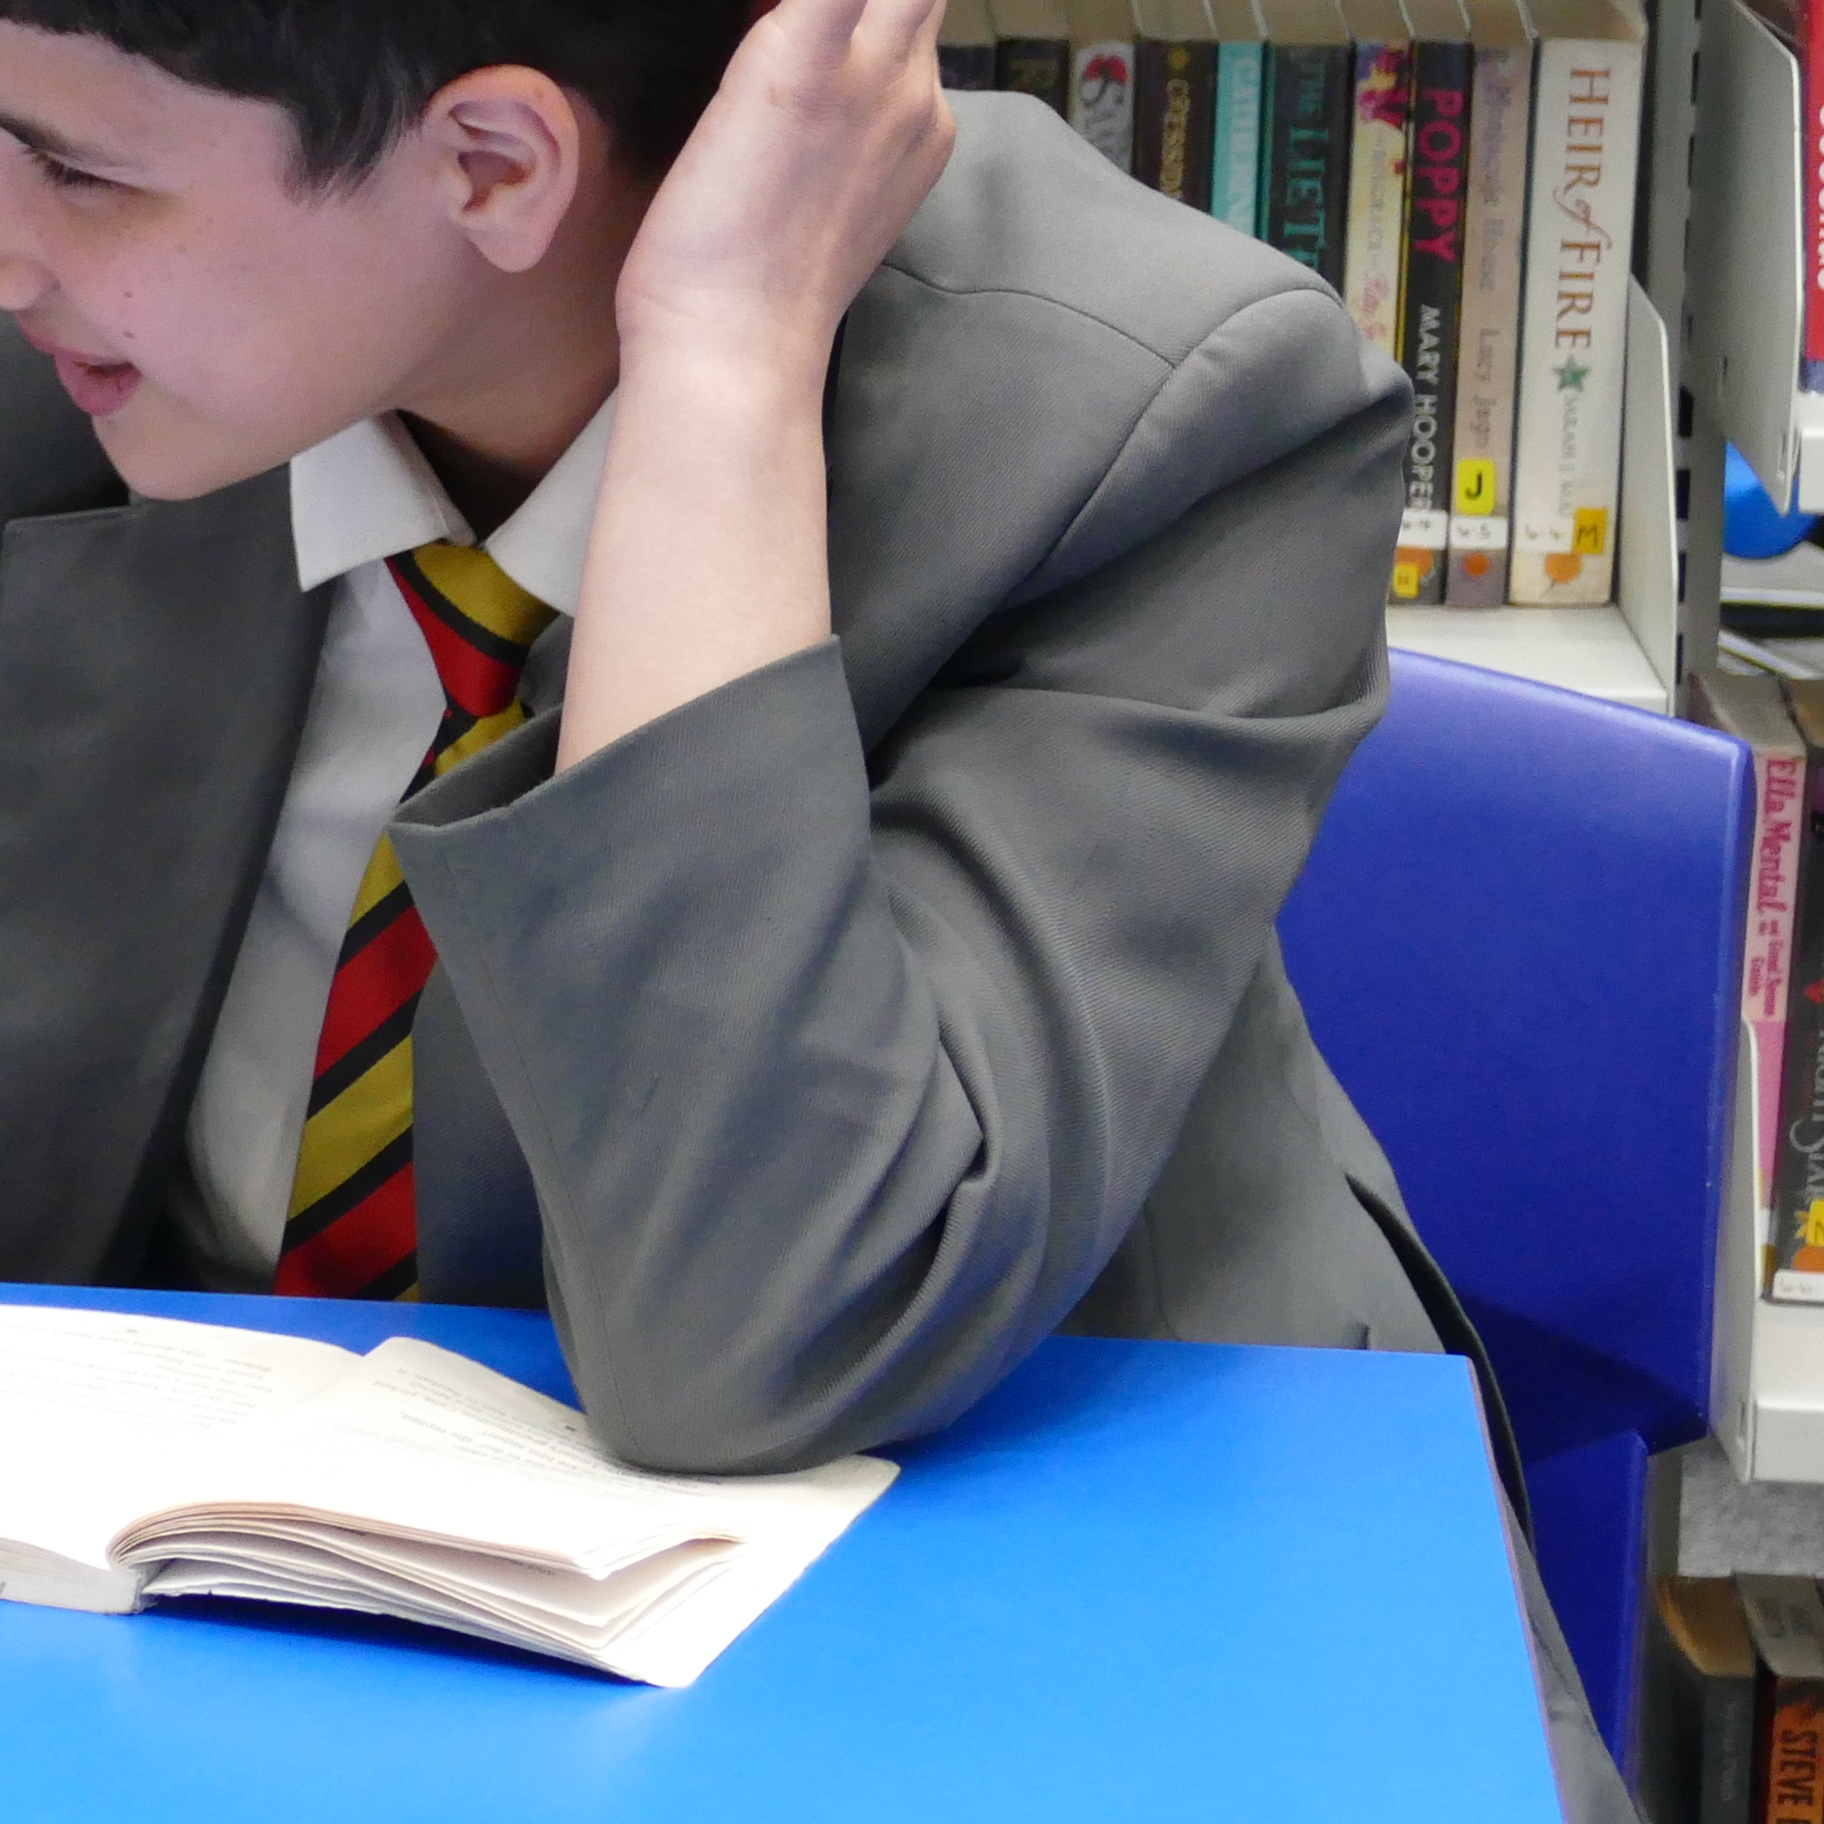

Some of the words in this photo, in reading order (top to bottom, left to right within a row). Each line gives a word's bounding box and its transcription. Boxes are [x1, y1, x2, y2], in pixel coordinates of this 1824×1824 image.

[1412, 87, 1465, 265] POPPY
[1560, 67, 1612, 192] HEIR
[1414, 302, 1445, 383] MARY
[1554, 241, 1602, 352] FIRE
[1760, 755, 1800, 814] Ella
[1754, 819, 1794, 918] Mental
[1776, 1728, 1819, 1808] STEVE
